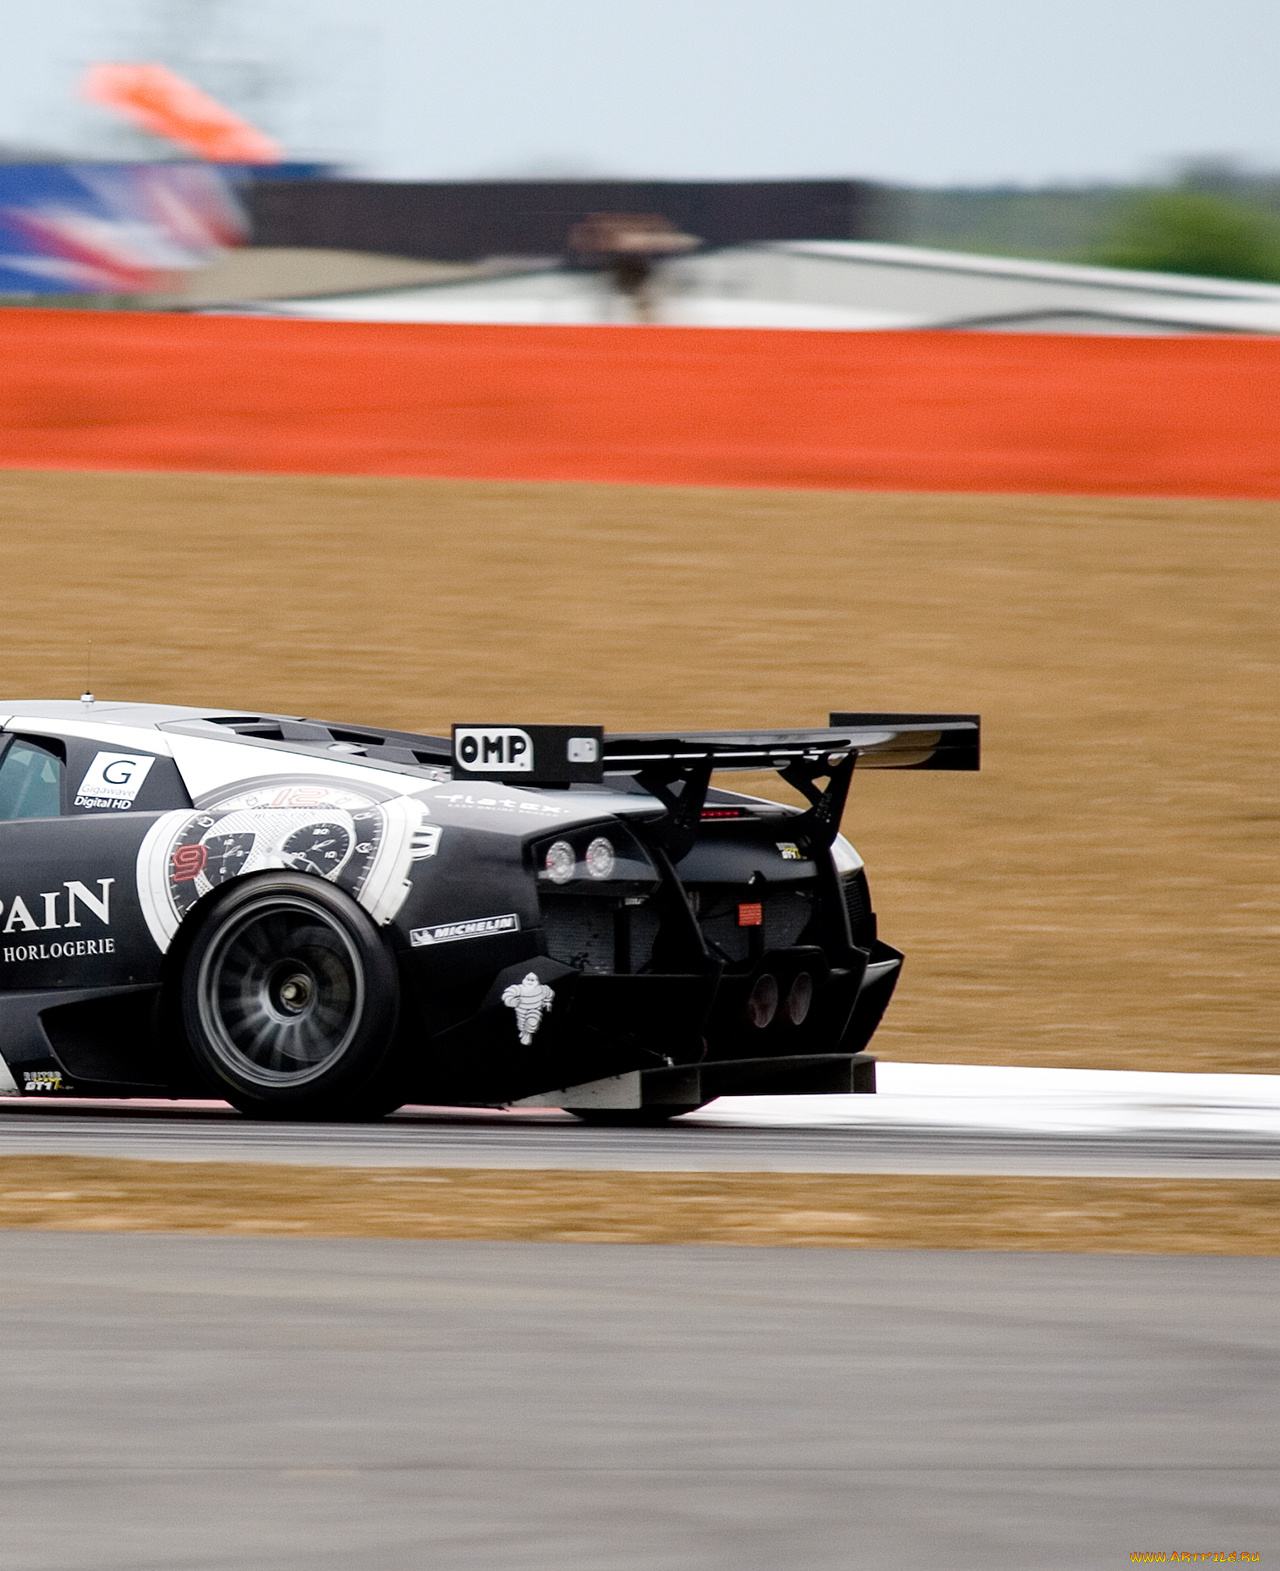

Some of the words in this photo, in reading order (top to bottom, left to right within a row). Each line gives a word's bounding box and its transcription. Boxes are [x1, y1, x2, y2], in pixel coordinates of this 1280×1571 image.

[461, 735, 526, 764] OMP
[102, 760, 136, 784] G
[81, 784, 135, 797] Gigawave
[74, 796, 112, 809] Digital
[112, 800, 132, 810] HD
[434, 917, 513, 938] MICHELIN
[4, 938, 116, 962] HORLOGERIE
